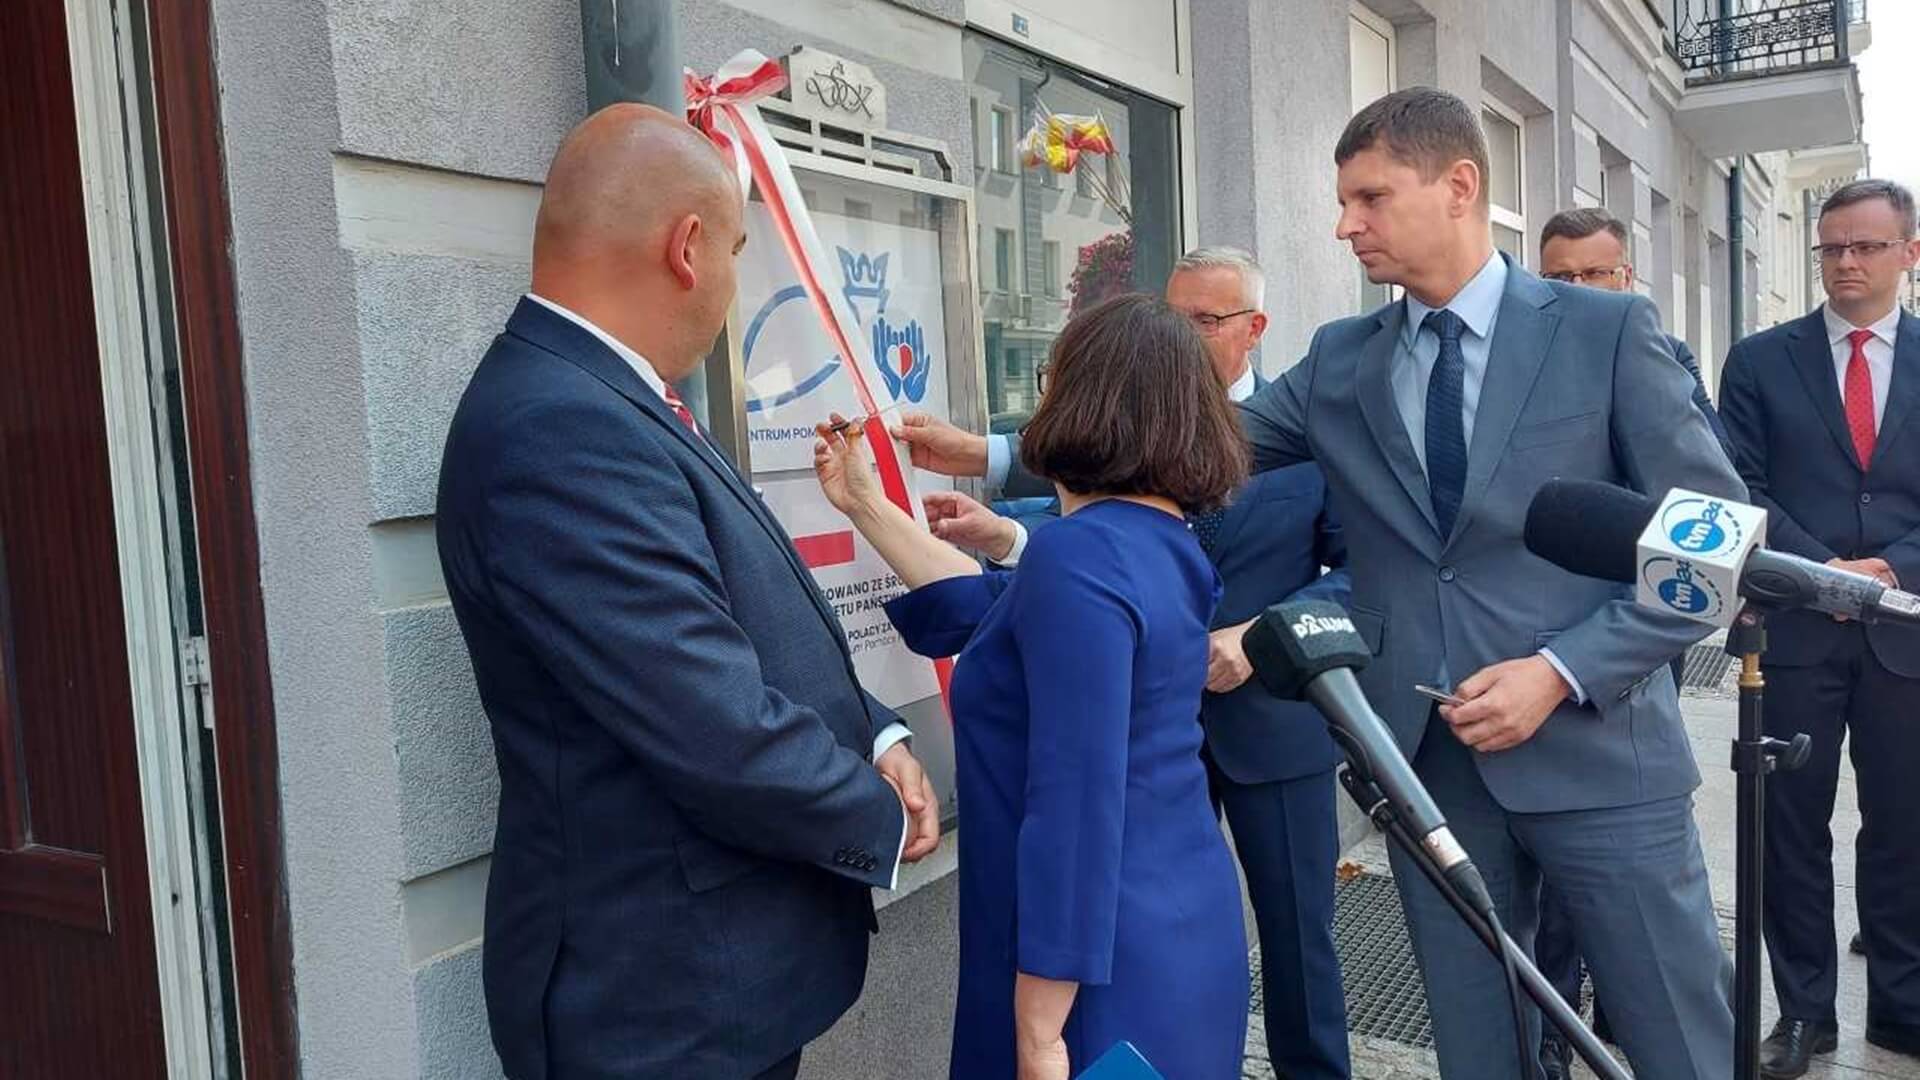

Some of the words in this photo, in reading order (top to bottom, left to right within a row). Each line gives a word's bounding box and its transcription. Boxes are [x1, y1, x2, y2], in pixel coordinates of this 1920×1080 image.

[750, 428, 791, 441] NTRUM
[793, 426, 817, 439] POM
[823, 580, 869, 601] OWANO
[871, 578, 883, 592] ZE
[833, 602, 854, 617] ETU
[848, 625, 880, 642] POLACY
[880, 622, 893, 634] ZA
